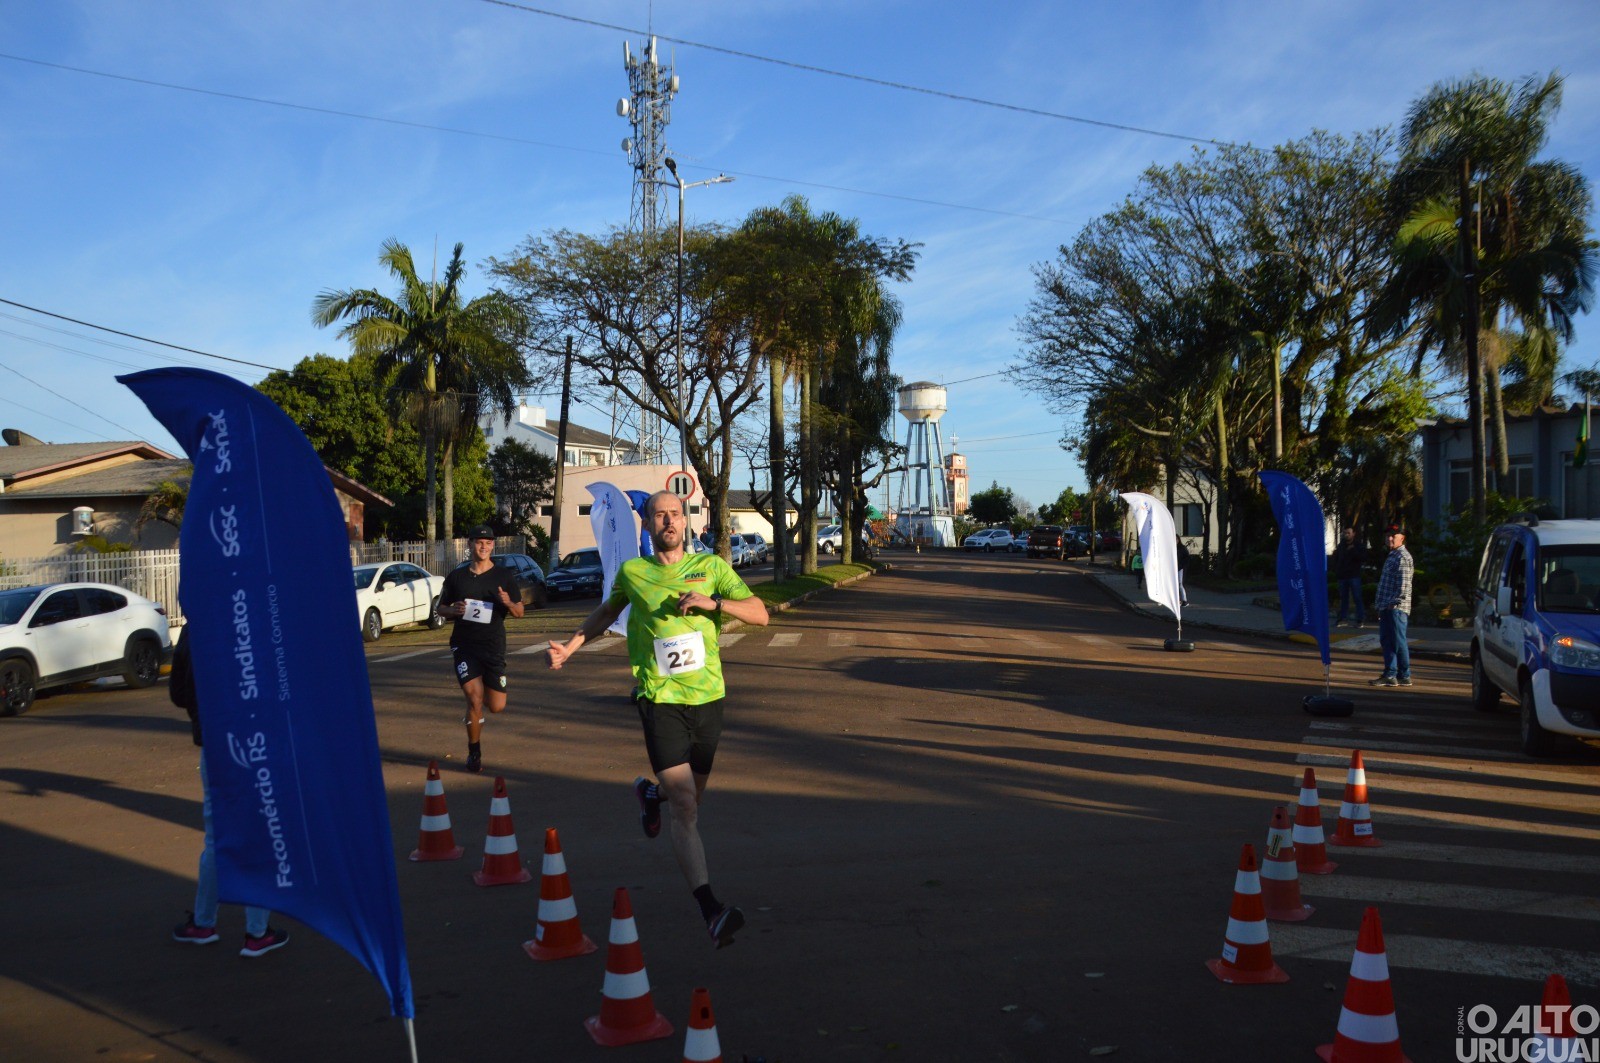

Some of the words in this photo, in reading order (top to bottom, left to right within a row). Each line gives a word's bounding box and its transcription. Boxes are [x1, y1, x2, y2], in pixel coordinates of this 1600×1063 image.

[214, 408, 232, 474] Senac
[222, 504, 240, 557] Sesc
[268, 584, 282, 644] Comércio
[472, 608, 481, 619] 2
[232, 588, 258, 700] Sindicatos
[457, 661, 468, 675] 69
[667, 648, 696, 669] 22
[278, 646, 291, 701] Sistema
[249, 731, 266, 764] RS
[254, 767, 293, 888] Fecomércio
